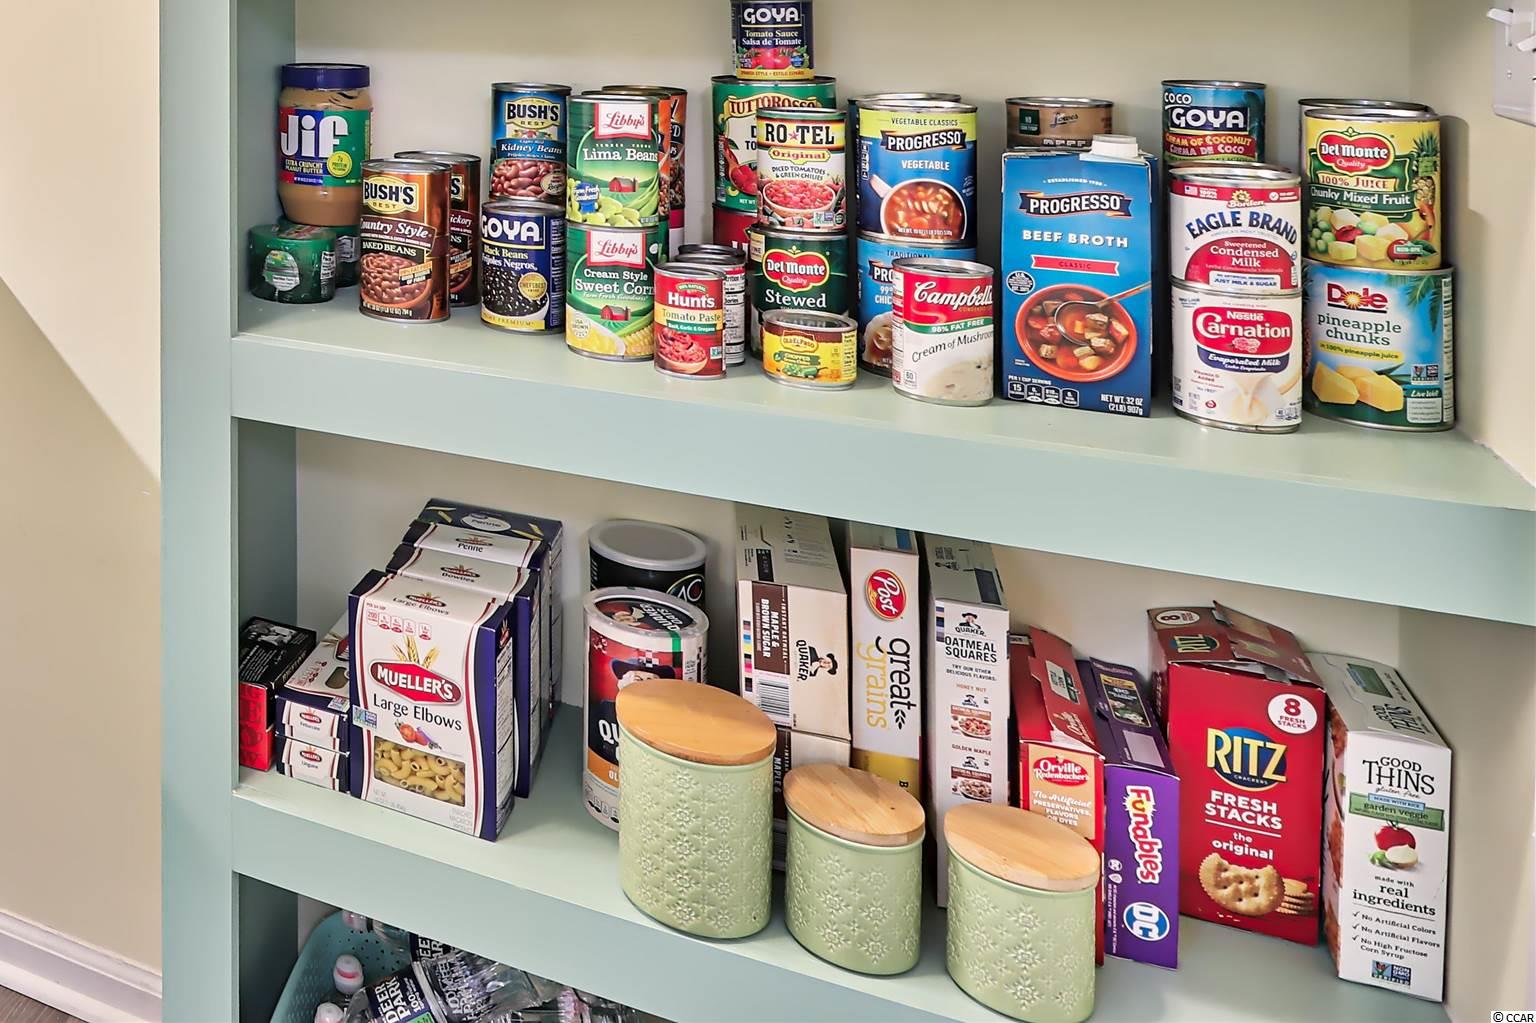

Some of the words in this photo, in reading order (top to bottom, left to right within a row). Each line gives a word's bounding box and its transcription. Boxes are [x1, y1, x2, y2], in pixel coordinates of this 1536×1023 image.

[744, 7, 799, 23] GOYA
[745, 30, 774, 38] Tomato
[1164, 92, 1192, 105] COCO
[507, 104, 559, 122] BUSH'S
[603, 111, 645, 129] Libby's
[891, 118, 928, 126] VEGETABLE
[1172, 108, 1244, 128] GOYA
[281, 115, 349, 157] Jif
[765, 123, 788, 143] RO
[796, 126, 835, 145] TEL
[888, 131, 961, 151] PROGRESSO
[501, 144, 534, 152] Kidney
[537, 146, 562, 154] Beans
[582, 148, 622, 161] Lima
[625, 148, 658, 162] Beans
[772, 150, 826, 160] Original
[1321, 143, 1340, 156] Del
[1340, 145, 1388, 159] Monte
[790, 166, 826, 176] TOMATOES
[901, 160, 950, 171] VEGETABLE
[1337, 159, 1366, 168] Quality
[1321, 176, 1350, 186] 100%
[1354, 177, 1389, 189] JUICE
[364, 182, 414, 205] BUSH'S
[1311, 187, 1340, 202] Chunky
[1343, 191, 1378, 205] Mixed
[1382, 195, 1410, 205] Fruit
[1030, 195, 1121, 214] PROGRESSO
[1186, 211, 1243, 240] EAGLE
[1249, 211, 1297, 245] BRAND
[1023, 230, 1063, 243] BEEF
[1068, 233, 1128, 248] BROTH
[1224, 241, 1267, 249] Sweetened
[384, 245, 417, 257] BEANS
[502, 249, 528, 260] Beans
[595, 240, 638, 258] Libby's
[1210, 246, 1280, 258] Condensed
[767, 259, 784, 273] Del
[786, 261, 825, 276] Monte
[1058, 261, 1092, 270] CLASSIC
[1232, 258, 1261, 268] Milk
[584, 269, 619, 279] Cream
[623, 271, 648, 282] Style
[575, 279, 620, 293] Sweet
[624, 282, 655, 295] Corn
[1327, 282, 1388, 310] Dole
[668, 291, 715, 308] Hunt's
[765, 289, 827, 308] Stewed
[663, 308, 696, 322] Tomato
[699, 313, 721, 323] Paste
[1317, 313, 1402, 335] pineapple
[950, 323, 965, 332] FAT
[967, 319, 984, 328] FREE
[1196, 313, 1291, 339] Carnation
[1326, 327, 1391, 346] chunks
[912, 343, 946, 363] Cream
[947, 340, 956, 349] of
[957, 329, 993, 346] Mushroo
[1208, 354, 1260, 367] Evaporated
[1261, 358, 1281, 367] Milk
[873, 575, 900, 617] Post
[761, 598, 770, 630] BROWN
[955, 627, 986, 637] QUAKER
[763, 631, 771, 658] SUGAR
[944, 636, 997, 653] OATMEAL
[1174, 634, 1211, 653] RITZ
[795, 639, 810, 682] QUAKER
[945, 647, 998, 664] SQUARES
[377, 663, 454, 701] MUELLER'S
[876, 636, 917, 710] great
[856, 642, 888, 729] grains
[373, 693, 408, 718] Large
[413, 706, 462, 732] Elbows
[1284, 698, 1301, 717] 8
[1277, 720, 1307, 730] STACKS
[1280, 715, 1306, 724] FRESH
[1207, 728, 1288, 782] RITZ
[1380, 756, 1422, 772] GOOD
[1040, 760, 1082, 774] Orville
[1234, 775, 1268, 785] CRACKERS
[1362, 760, 1435, 795] THINS
[1211, 790, 1277, 815] FRESH
[1364, 802, 1397, 814] garden
[1398, 809, 1429, 820] veggie
[1205, 803, 1283, 830] STACKS
[1127, 786, 1162, 884] Funables
[1233, 832, 1253, 843] the
[1212, 839, 1273, 860] original
[1375, 875, 1395, 883] made
[1397, 880, 1415, 888] with
[1380, 885, 1409, 898] real
[1352, 889, 1436, 916] ingredients
[1132, 904, 1160, 940] DC
[1362, 914, 1373, 922] No
[1375, 917, 1410, 930] Artificial
[1412, 925, 1436, 935] Colors
[1361, 926, 1373, 934] No
[1375, 929, 1410, 942] Artificial
[1412, 937, 1441, 948] Flavors
[1360, 945, 1379, 954] Corn
[1381, 951, 1405, 960] Syrup
[1374, 940, 1393, 950] High
[1395, 945, 1428, 957] Fructose
[375, 982, 399, 1023] DEER
[387, 976, 412, 1019] PARK
